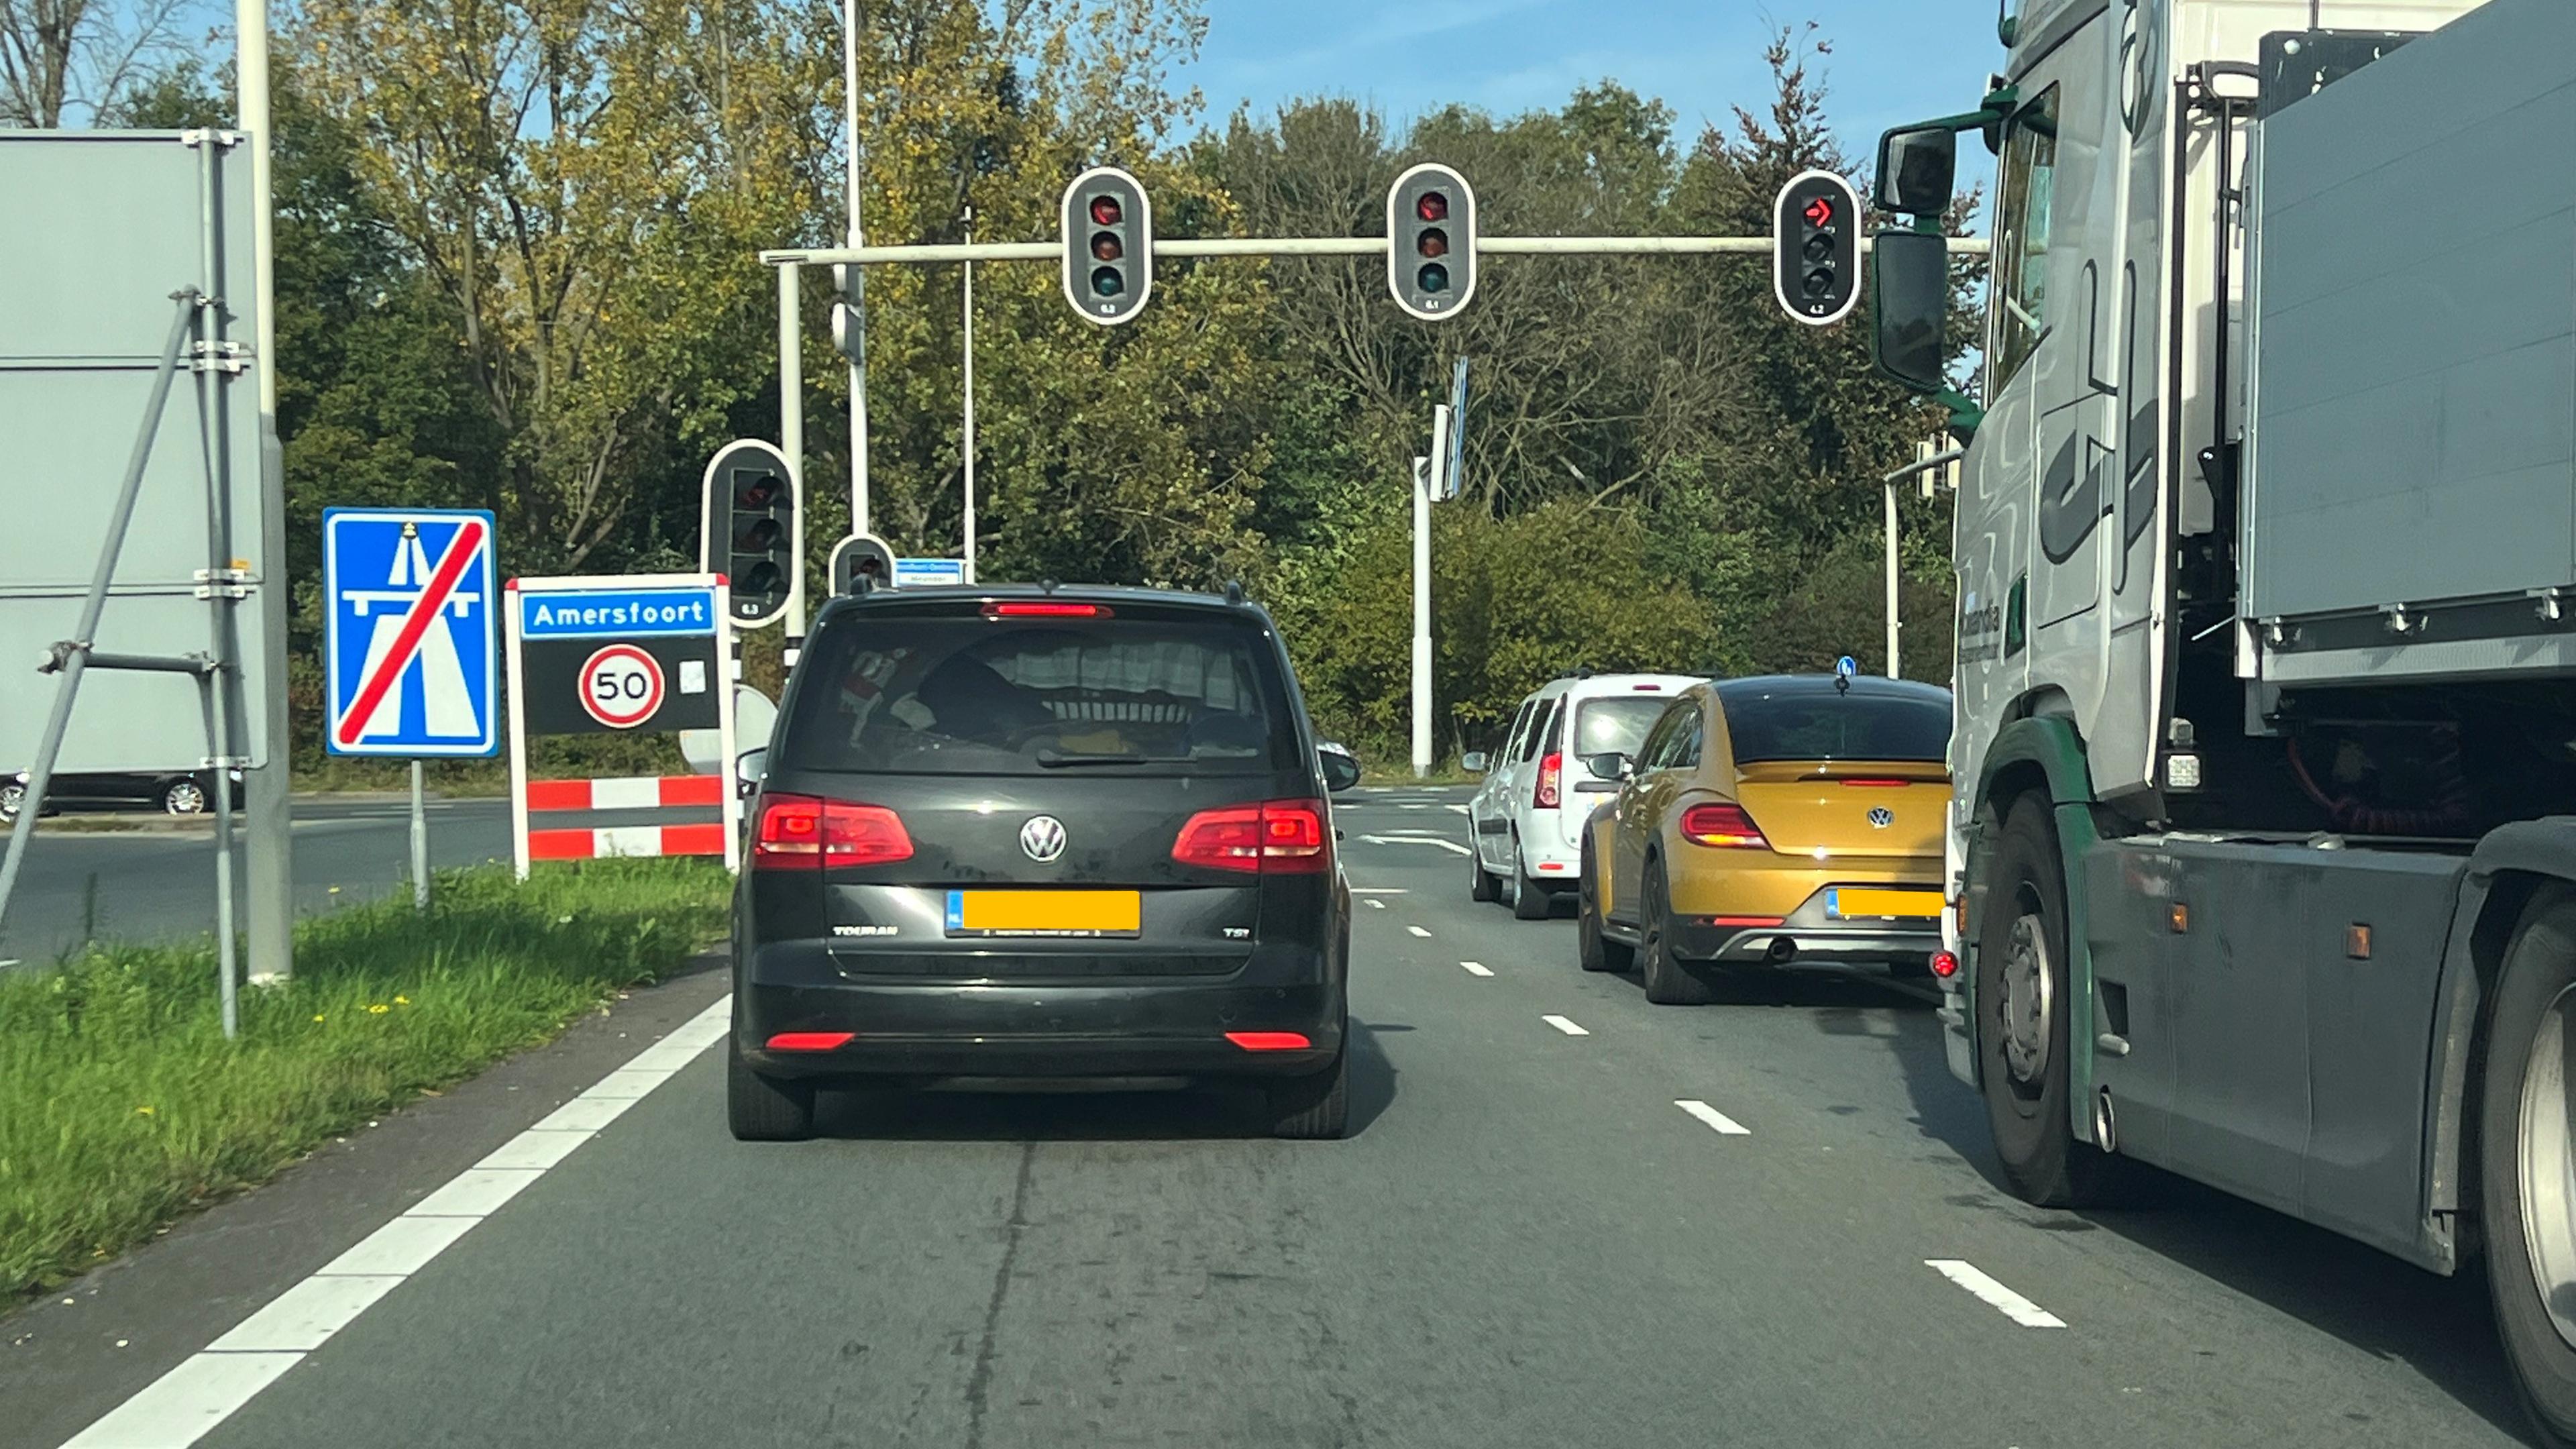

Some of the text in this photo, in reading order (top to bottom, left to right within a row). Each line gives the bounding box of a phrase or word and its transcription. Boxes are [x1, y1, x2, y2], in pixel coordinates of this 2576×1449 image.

[534, 602, 703, 625] Amersfoort
[597, 672, 647, 700] 50
[833, 926, 899, 936] TOURAN
